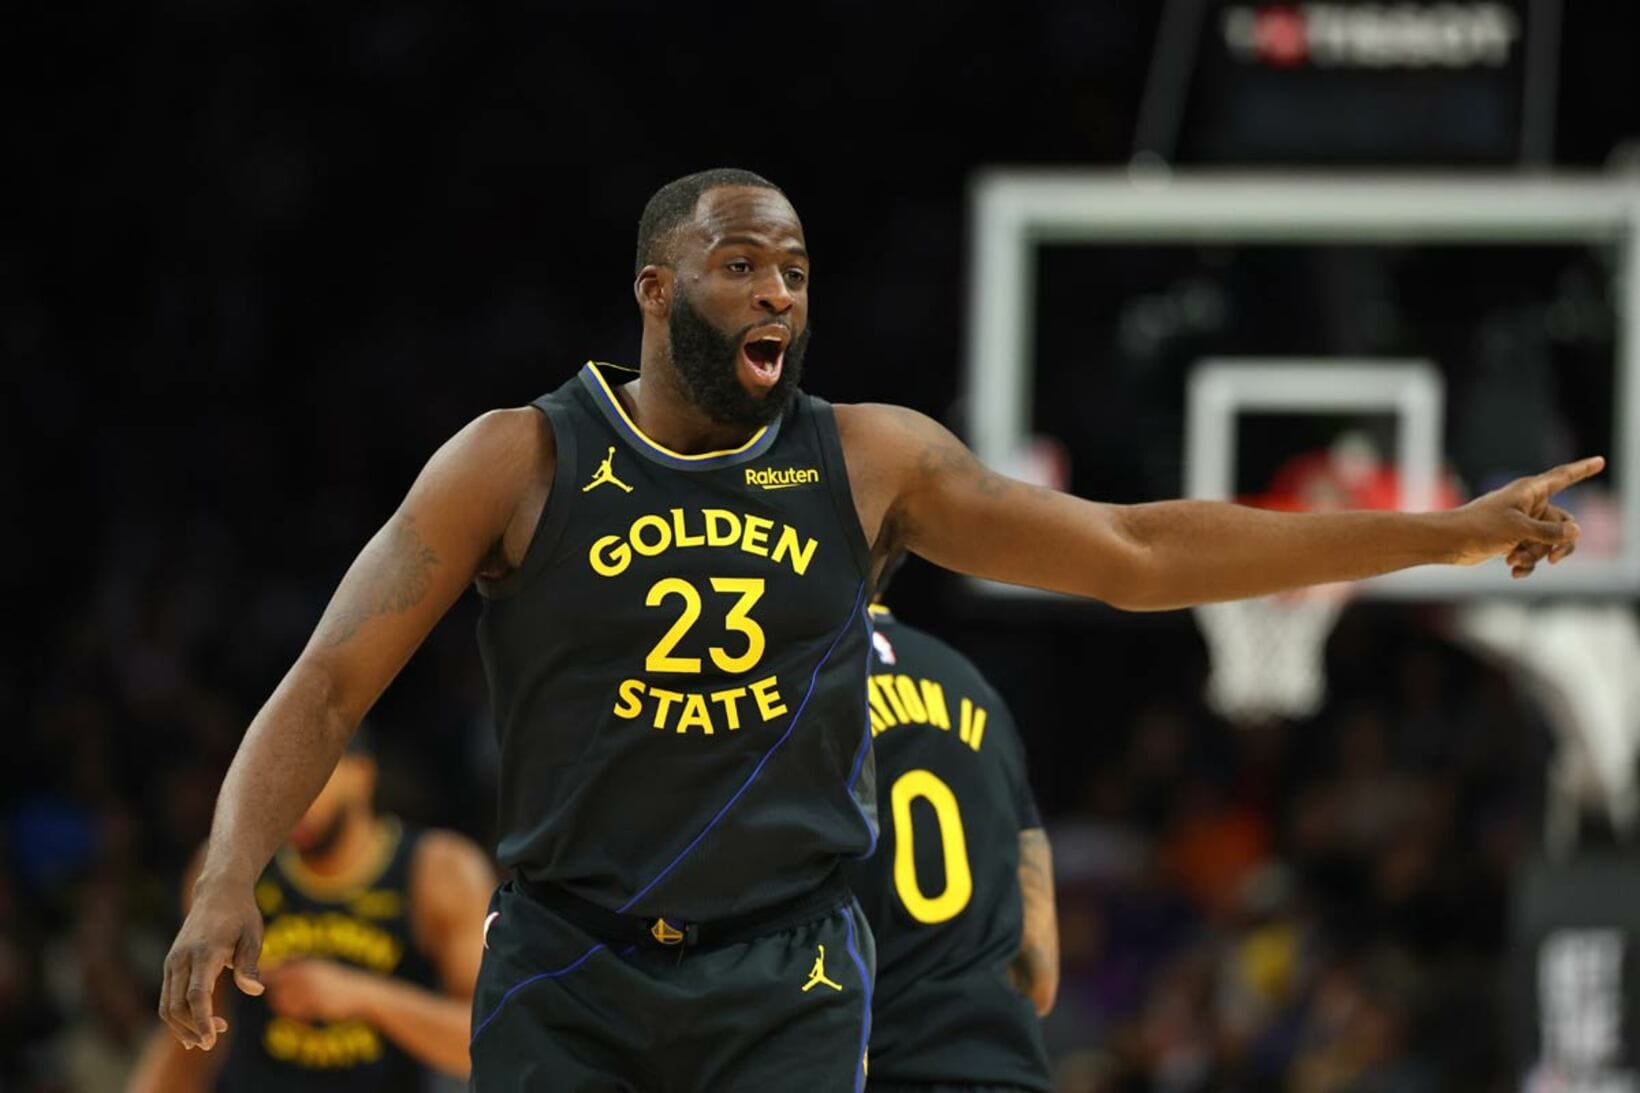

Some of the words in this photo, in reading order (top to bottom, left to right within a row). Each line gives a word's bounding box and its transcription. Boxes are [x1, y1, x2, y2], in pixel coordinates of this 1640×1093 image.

[744, 467, 820, 485] Rakuten
[588, 507, 818, 578] GOLDEN
[645, 576, 767, 674] 23
[613, 675, 788, 735] STATE
[891, 768, 973, 925] 0
